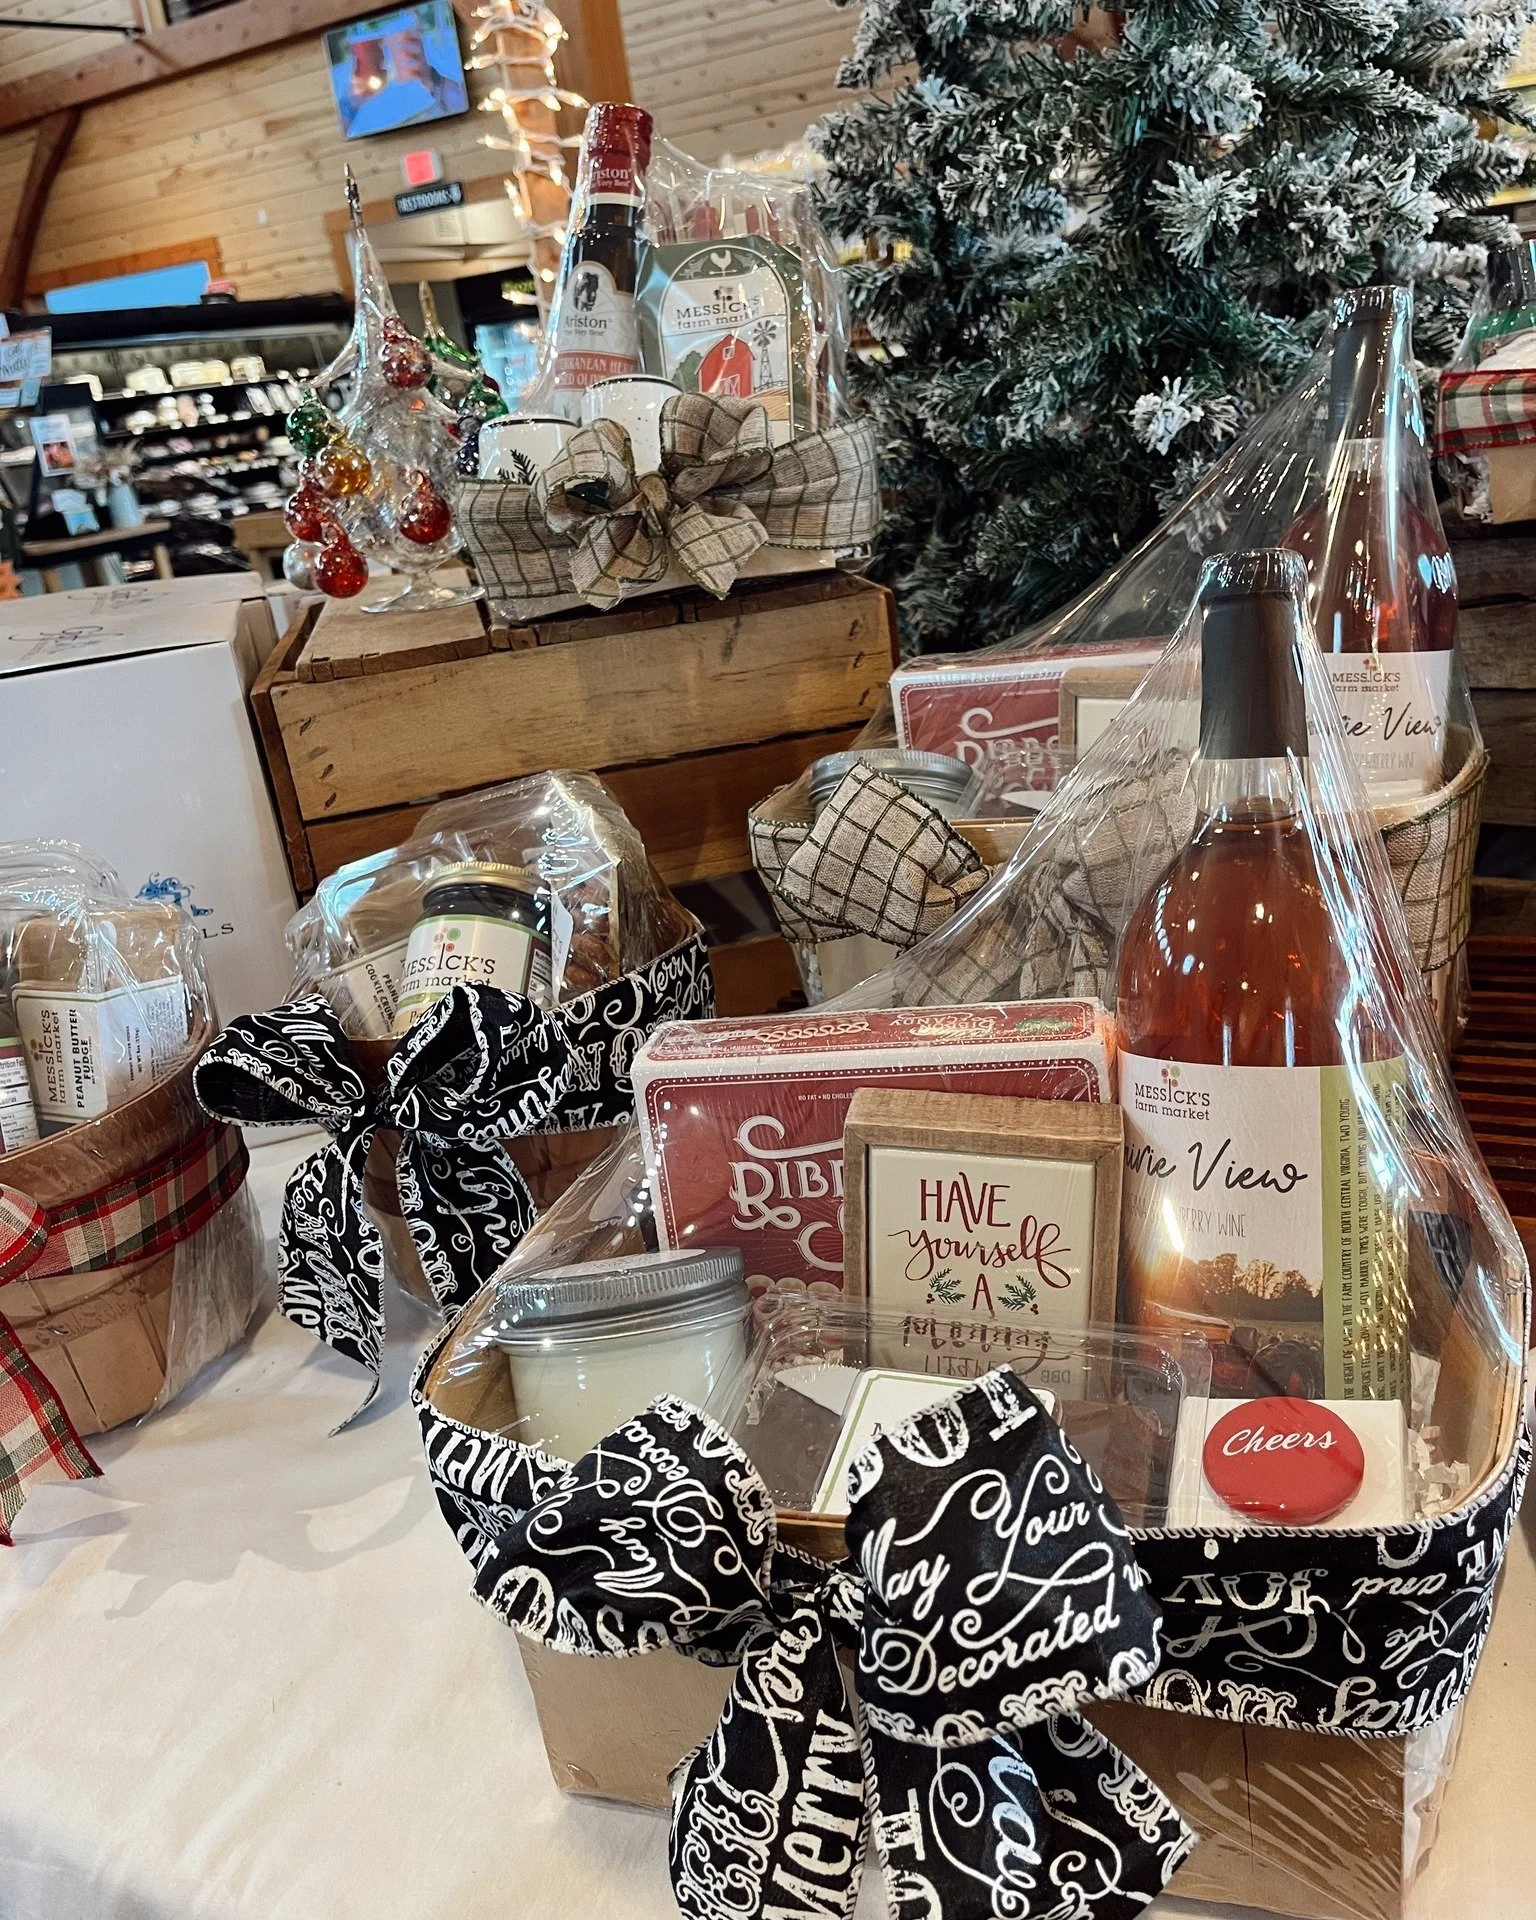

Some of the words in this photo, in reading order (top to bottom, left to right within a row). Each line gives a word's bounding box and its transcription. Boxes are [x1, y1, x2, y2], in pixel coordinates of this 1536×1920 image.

[51, 1011, 63, 1064] market
[69, 1009, 80, 1053] BUTTER
[39, 1009, 58, 1103] MESSICK'S
[81, 1039, 92, 1080] FUDGE
[72, 1056, 85, 1109] PEANUT
[1135, 1078, 1210, 1107] MESSICK'S
[1134, 1098, 1158, 1114] farm
[1162, 1105, 1210, 1121] market
[1340, 1098, 1350, 1122] YOUNG
[1340, 1124, 1350, 1142] TWO
[1188, 1139, 1308, 1194] View
[1358, 1144, 1367, 1167] YOUNG
[1358, 1170, 1367, 1184] BUT
[920, 1172, 1011, 1233] HAVE
[1341, 1178, 1351, 1209] CENTRAL
[1358, 1186, 1369, 1212] TOUGH,
[1217, 1211, 1247, 1238] WINE
[1341, 1211, 1351, 1234] NORTH
[1359, 1215, 1368, 1233] WERE
[887, 1215, 1071, 1288] yourself
[1342, 1236, 1352, 1246] OF
[1359, 1235, 1369, 1255] TIMES
[1341, 1249, 1352, 1280] COUNTRY
[971, 1273, 996, 1319] A
[1342, 1283, 1352, 1301] FARM
[1360, 1291, 1369, 1305] GOT
[1342, 1303, 1353, 1316] THE
[1222, 1427, 1337, 1457] Cheers
[868, 1574, 1121, 1697] Decorated
